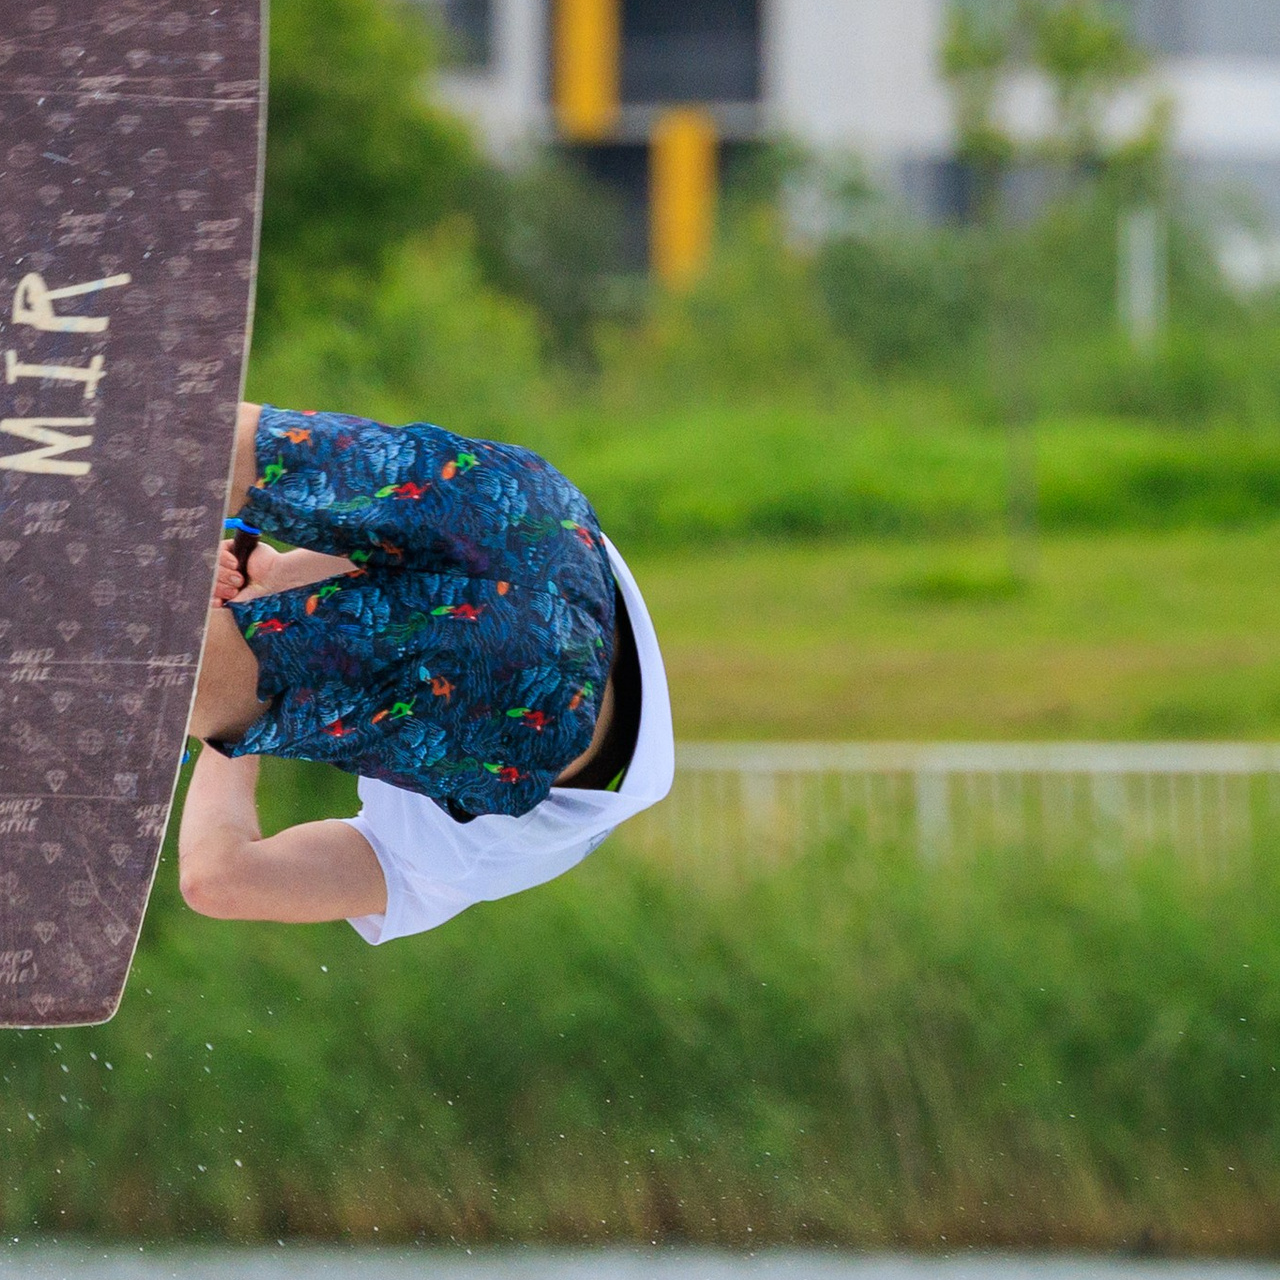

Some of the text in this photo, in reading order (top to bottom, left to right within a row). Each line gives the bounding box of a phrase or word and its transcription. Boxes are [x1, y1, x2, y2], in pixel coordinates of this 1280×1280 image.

[9, 647, 54, 664] SHRED
[11, 667, 51, 683] STYLE
[148, 672, 188, 688] STYLE
[135, 804, 170, 819] SHRE
[0, 817, 39, 834] STYLE
[137, 824, 165, 838] STY
